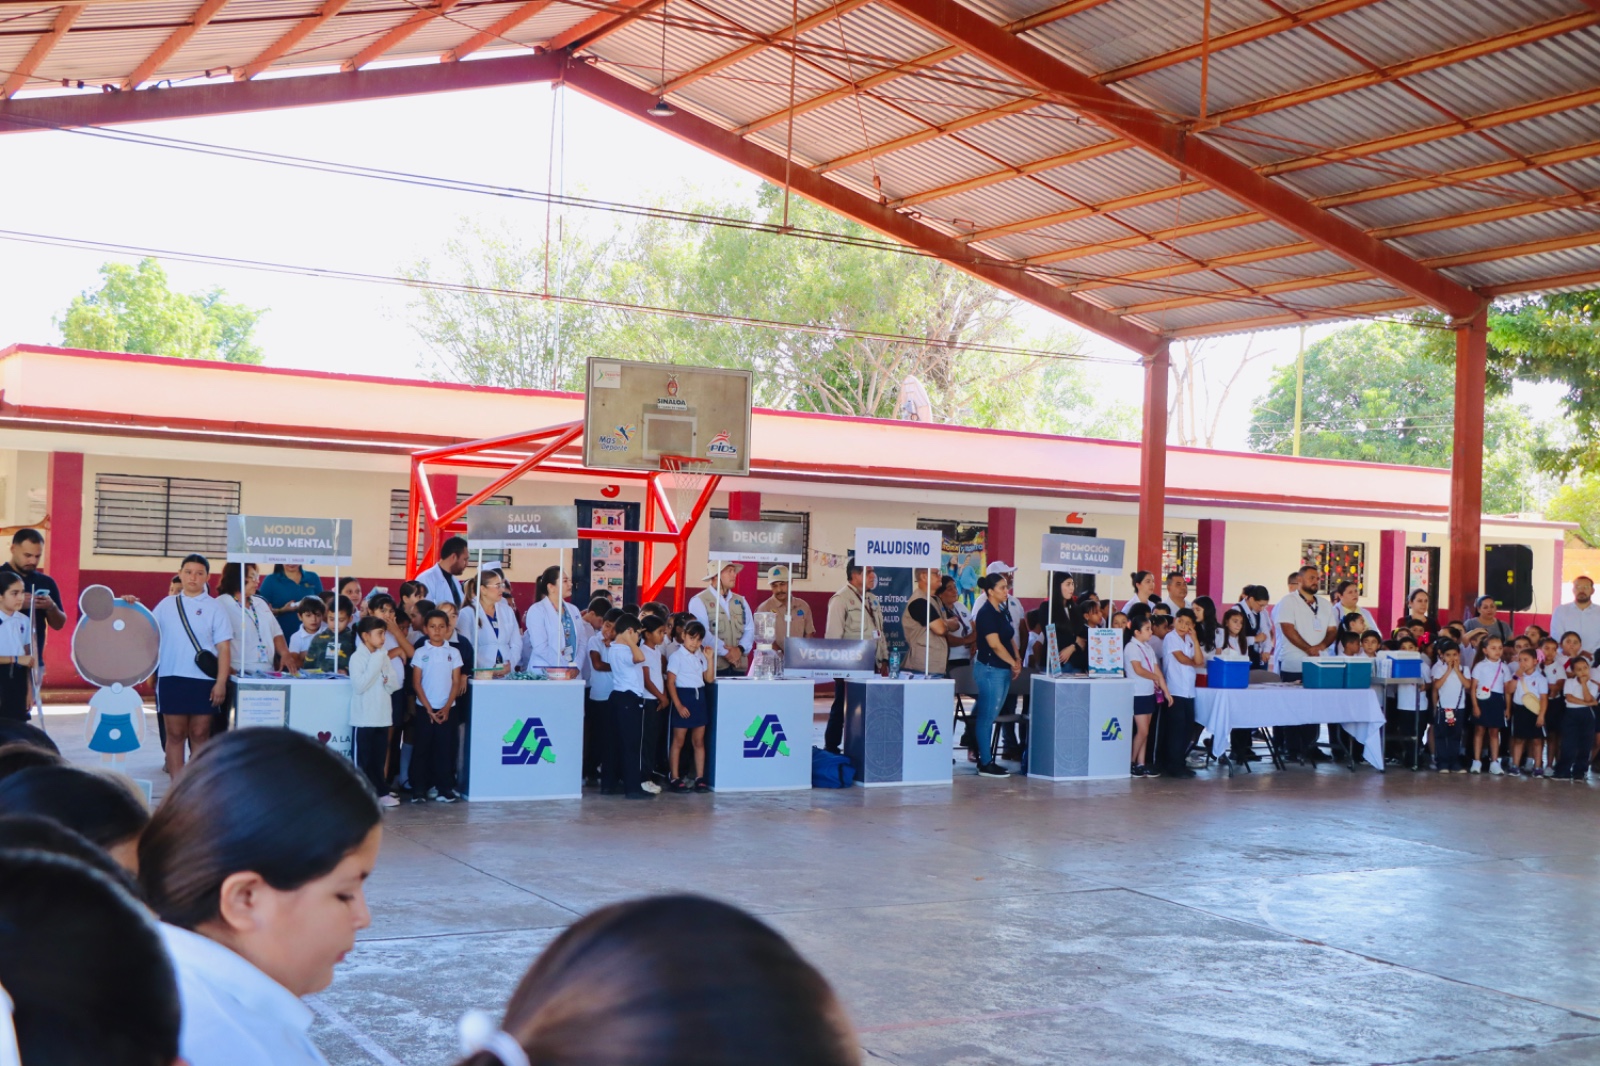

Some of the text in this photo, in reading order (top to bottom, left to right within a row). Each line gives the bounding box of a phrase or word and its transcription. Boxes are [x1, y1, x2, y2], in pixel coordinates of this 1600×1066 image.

[508, 514, 542, 523] SALUD
[264, 524, 316, 536] MODULO
[507, 524, 542, 533] BUCAL
[246, 536, 332, 549] SALUD MENTAL
[732, 531, 784, 544] DENGUE
[867, 540, 930, 556] PALUDISMO
[1060, 542, 1110, 553] PROMOCIÓN
[1060, 552, 1109, 562] DE LA SALUD
[884, 594, 908, 603] FÚTBOL
[799, 647, 863, 661] VECTORES
